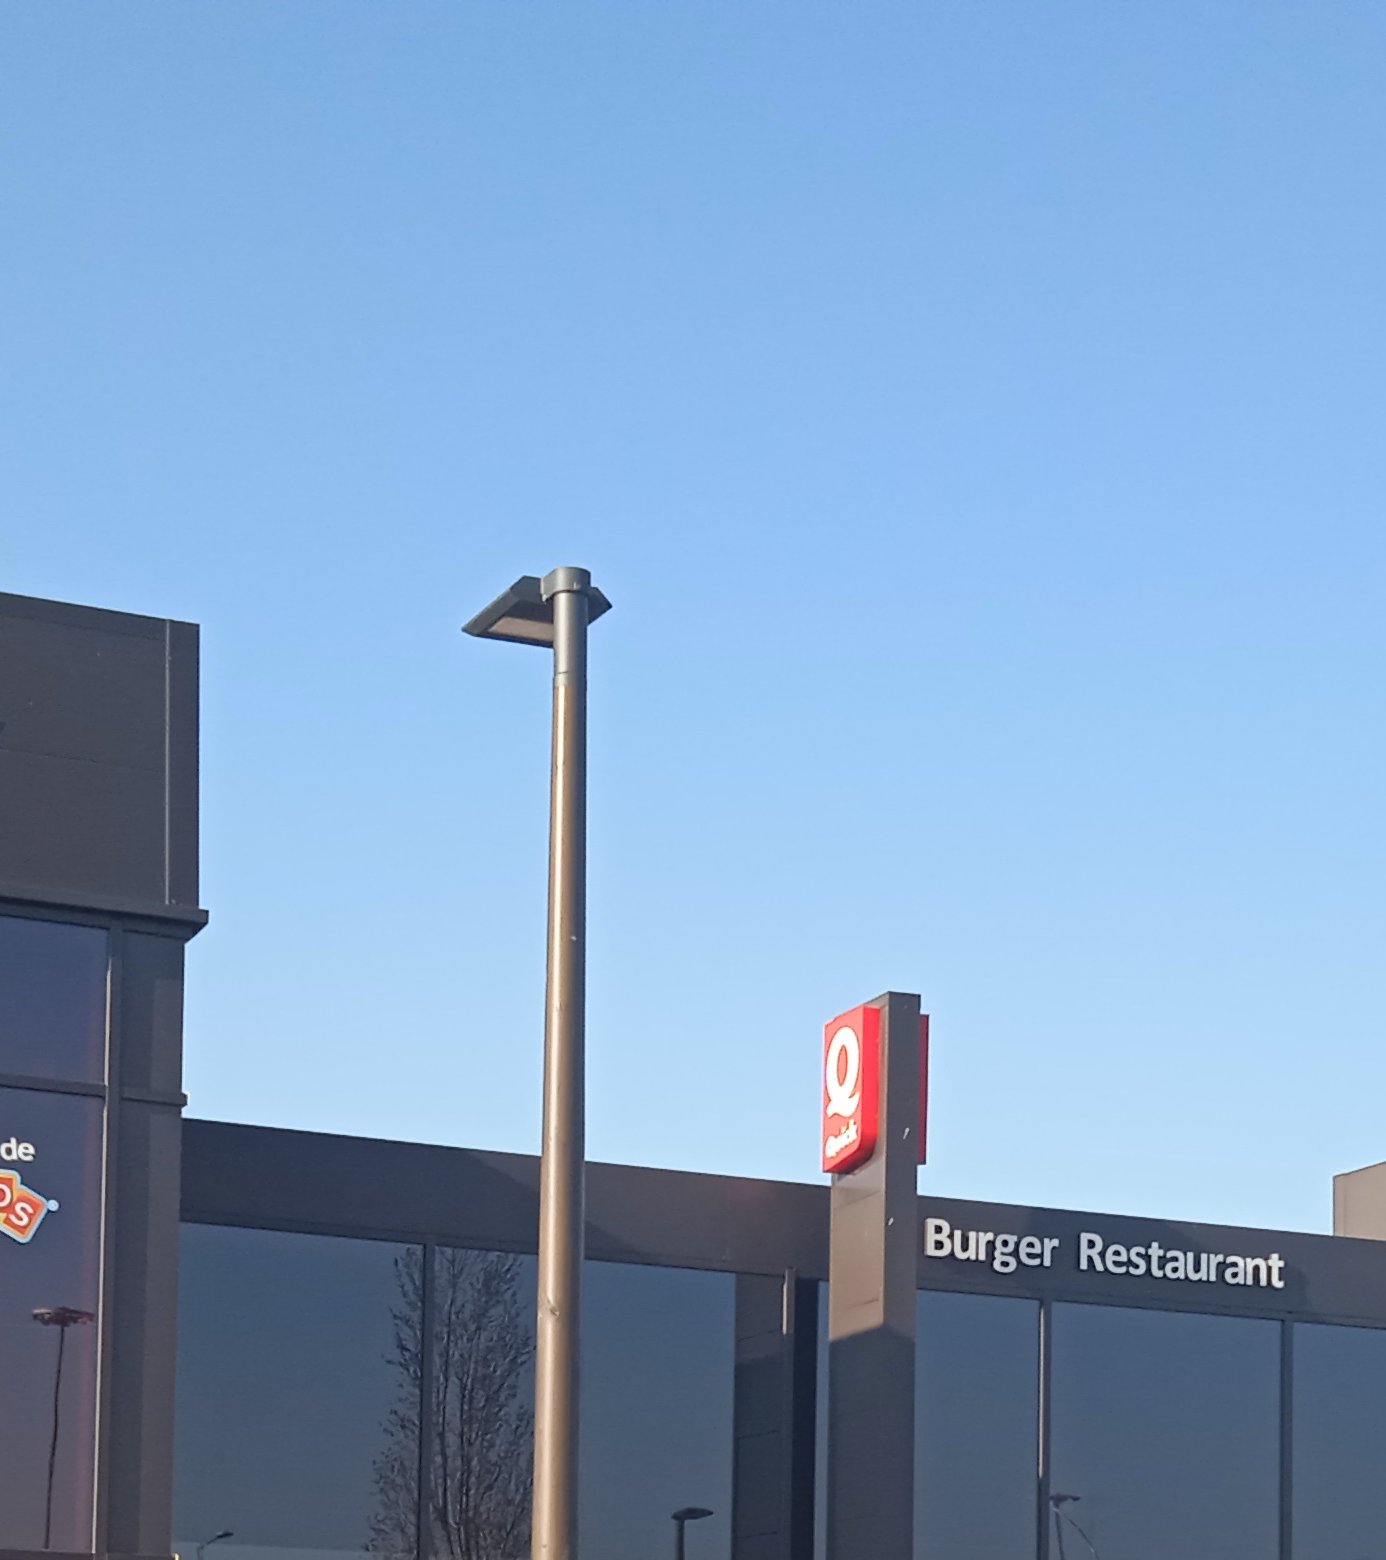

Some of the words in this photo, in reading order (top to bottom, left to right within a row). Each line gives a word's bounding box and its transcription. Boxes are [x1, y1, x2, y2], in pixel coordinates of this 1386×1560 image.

[826, 1025, 860, 1118] Q
[0, 1137, 36, 1161] de
[925, 1217, 1059, 1274] Burger
[1078, 1232, 1286, 1289] Restaurant
